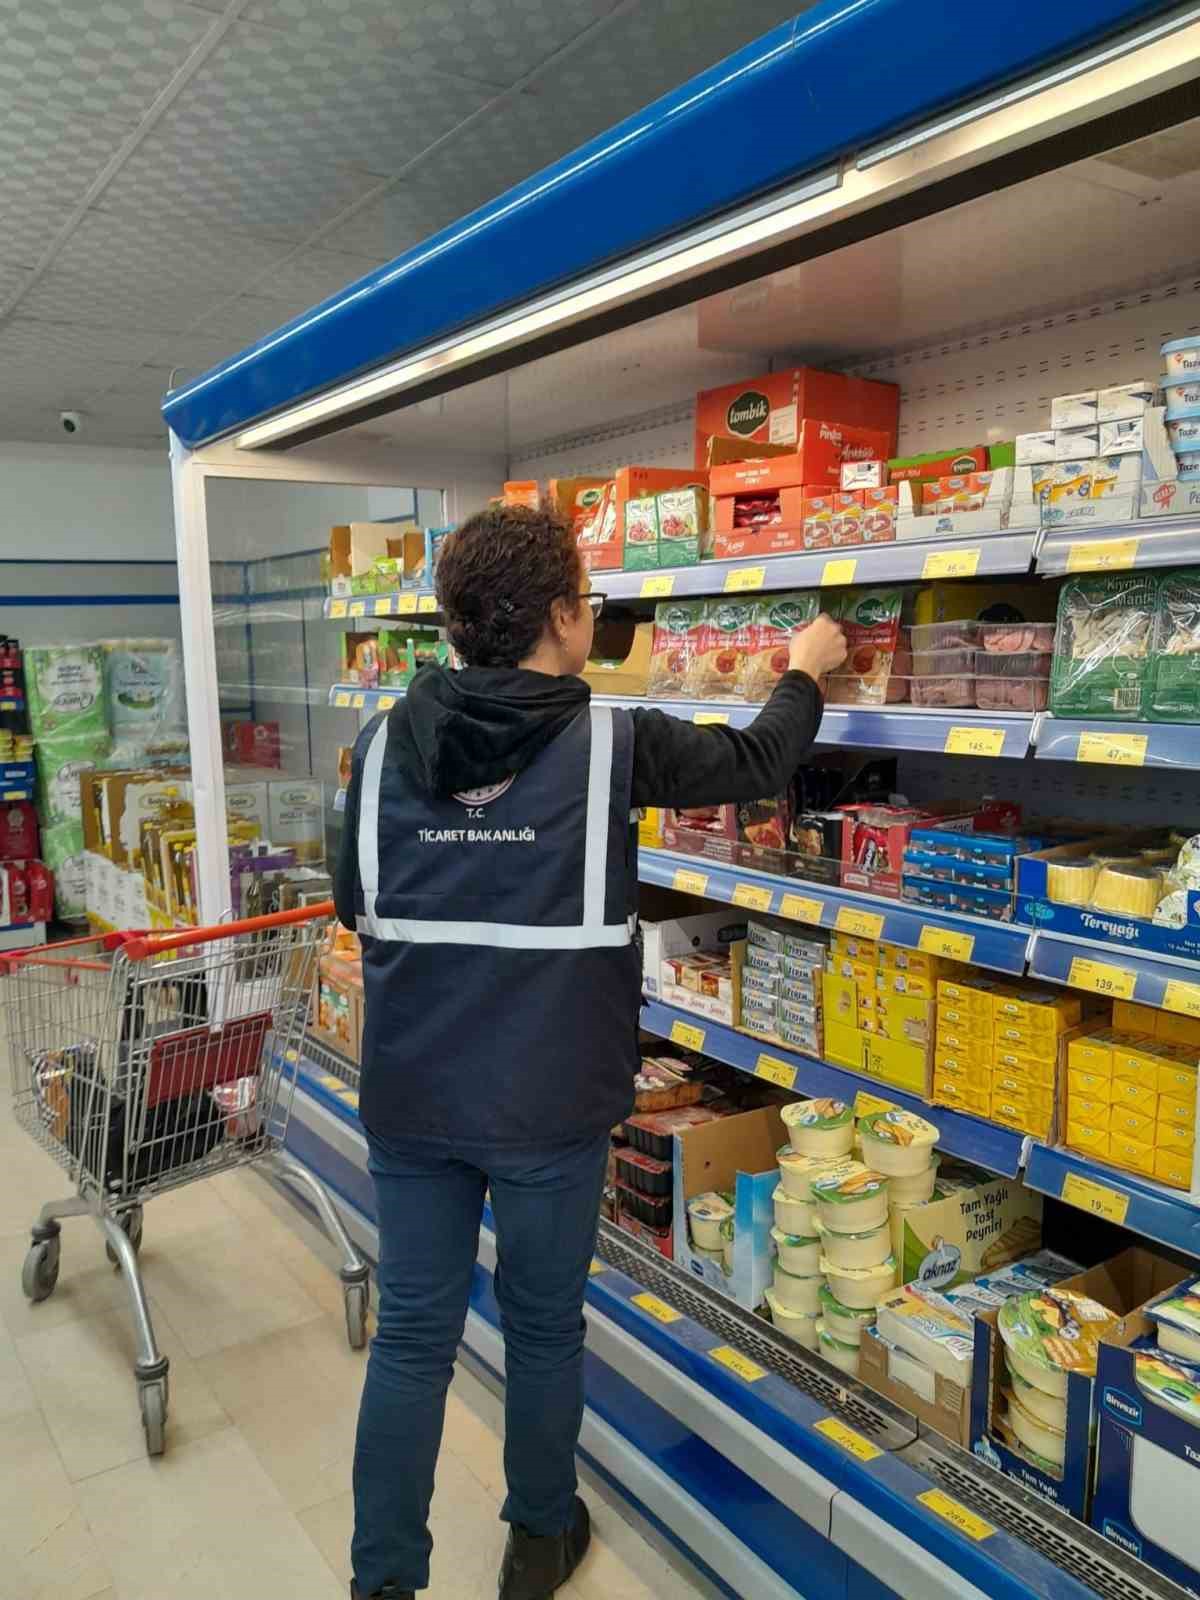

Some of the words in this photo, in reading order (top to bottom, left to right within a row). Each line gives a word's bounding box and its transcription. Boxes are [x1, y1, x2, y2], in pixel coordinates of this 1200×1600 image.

[729, 399, 768, 424] tombik
[418, 827, 466, 842] TİCARET
[467, 826, 536, 842] BAKANLIĞI
[1080, 912, 1140, 940] Tereyağı
[960, 1199, 982, 1216] Tam
[983, 1188, 1009, 1206] Yağlı
[974, 1209, 995, 1225] Tost
[966, 1218, 1002, 1242] Peyniri
